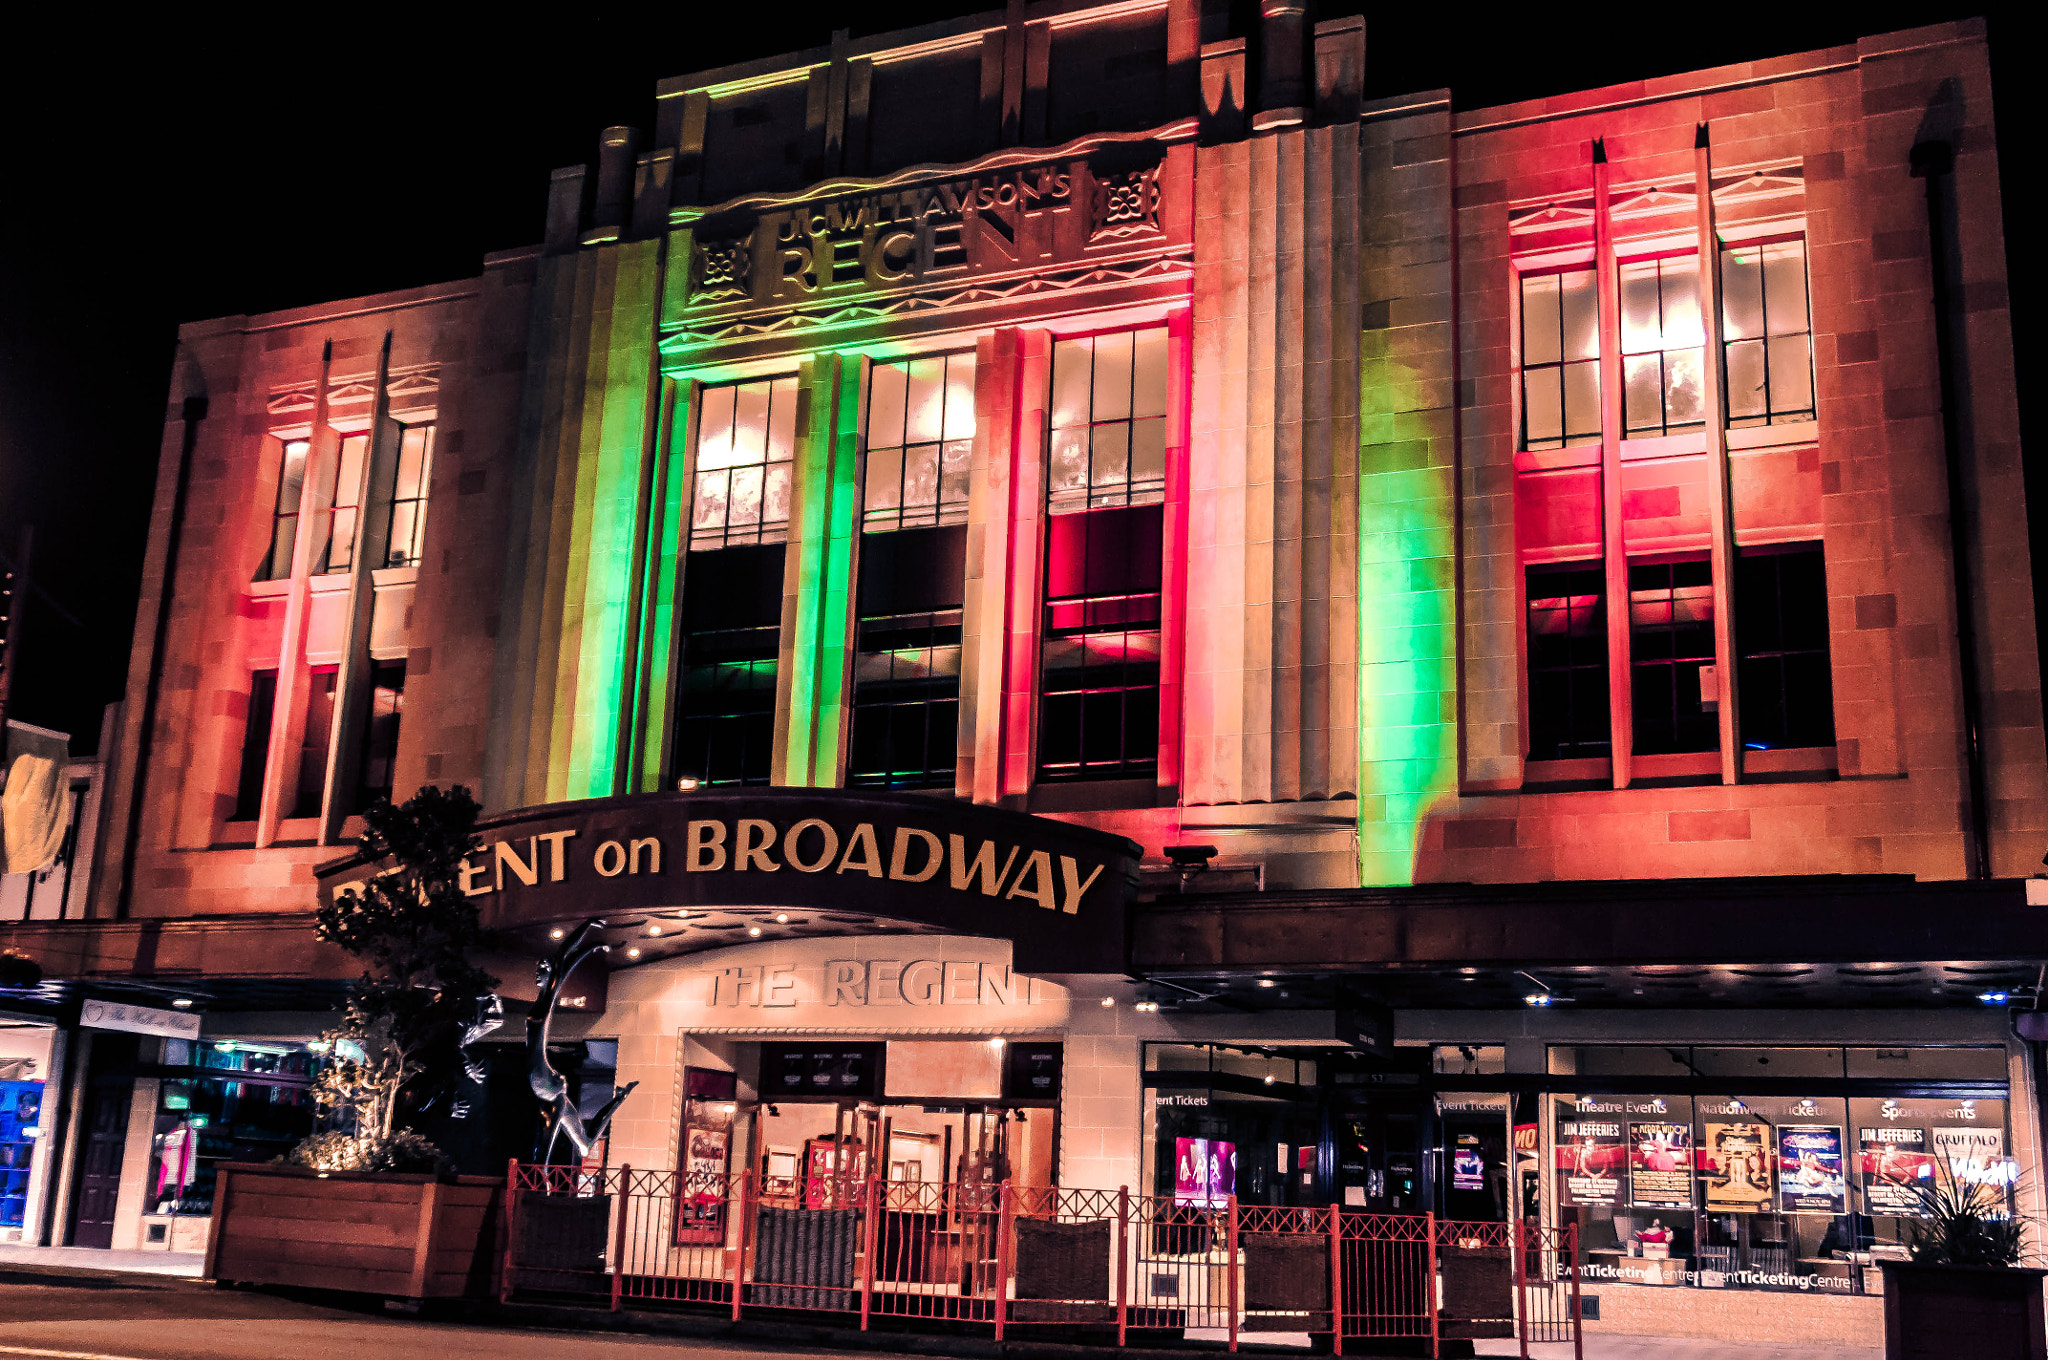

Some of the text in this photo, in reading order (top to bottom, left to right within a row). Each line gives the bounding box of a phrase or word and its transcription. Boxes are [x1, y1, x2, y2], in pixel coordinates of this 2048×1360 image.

[772, 203, 1073, 297] REGENT
[593, 837, 661, 877] on
[686, 817, 1105, 915] BROADWAY
[704, 958, 1045, 1008] THE REGENT
[1175, 1095, 1208, 1106] Tickets
[1436, 1100, 1506, 1111] Event Tickets
[1574, 1100, 1668, 1114] Theatre Events
[1881, 1104, 1976, 1121] Sports Events
[1563, 1123, 1620, 1137] JIM JEFFERIES
[1861, 1129, 1923, 1143] JIM JEFFERIES
[1935, 1133, 1998, 1146] GRUFFALO
